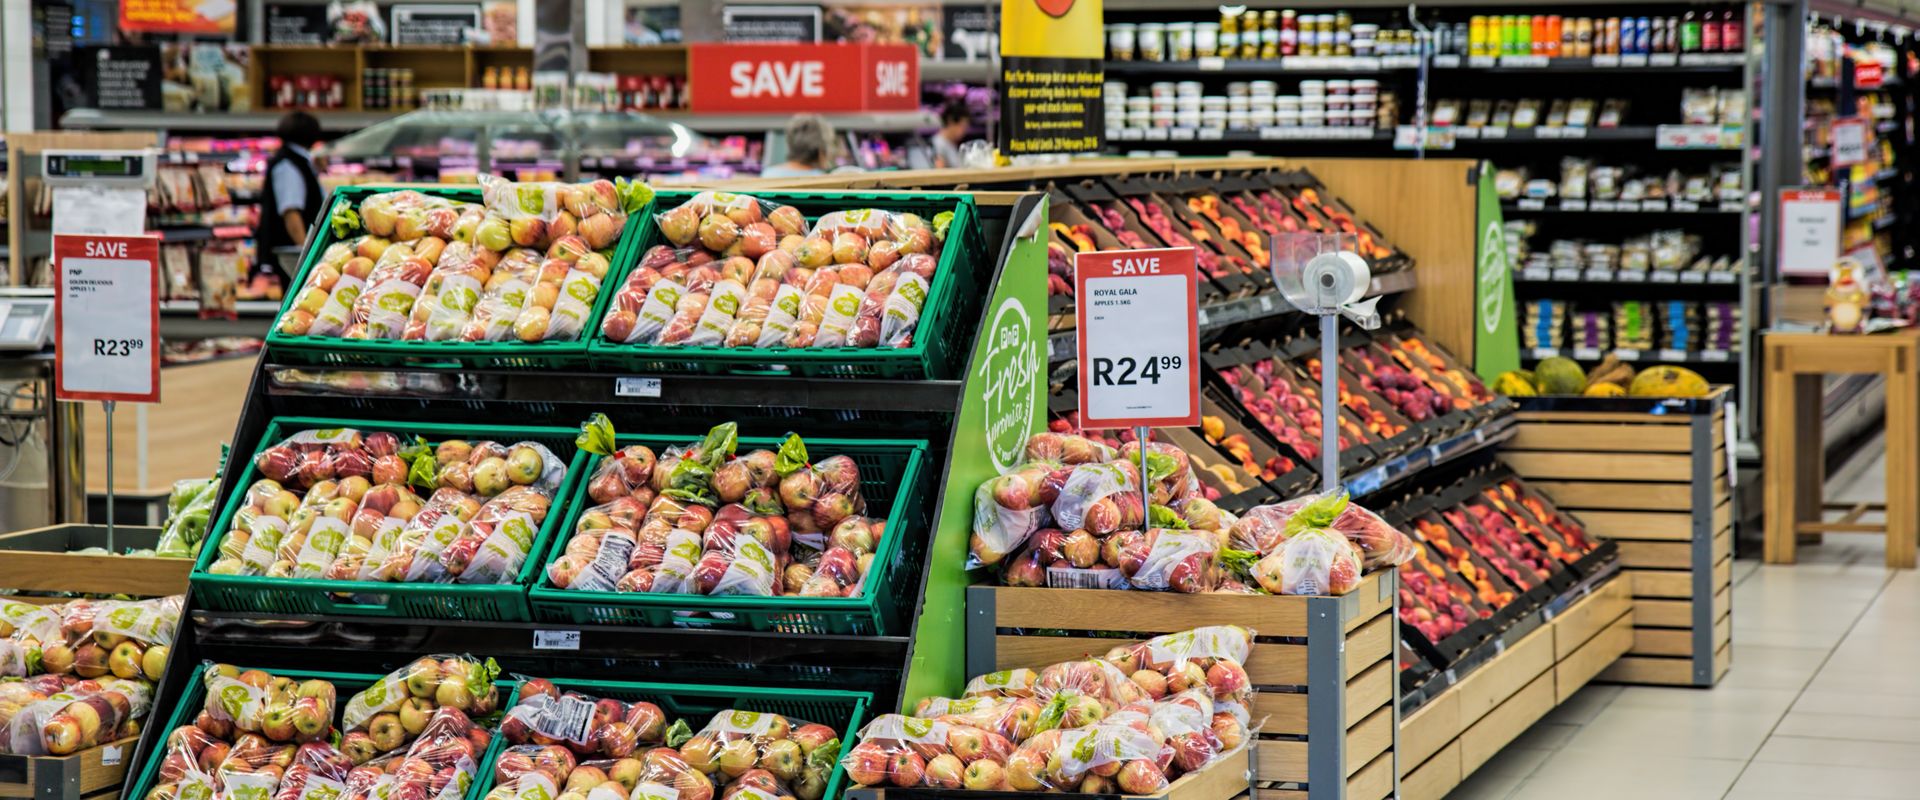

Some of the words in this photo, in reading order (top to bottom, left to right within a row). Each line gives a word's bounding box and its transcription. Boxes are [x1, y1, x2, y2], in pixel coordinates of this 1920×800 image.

[730, 61, 825, 97] SAVE
[876, 61, 908, 96] SAVE
[85, 241, 128, 257] SAVE
[1112, 257, 1160, 275] SAVE
[1118, 288, 1138, 296] GALA
[980, 315, 1040, 413] Fresh
[990, 401, 1022, 460] promise
